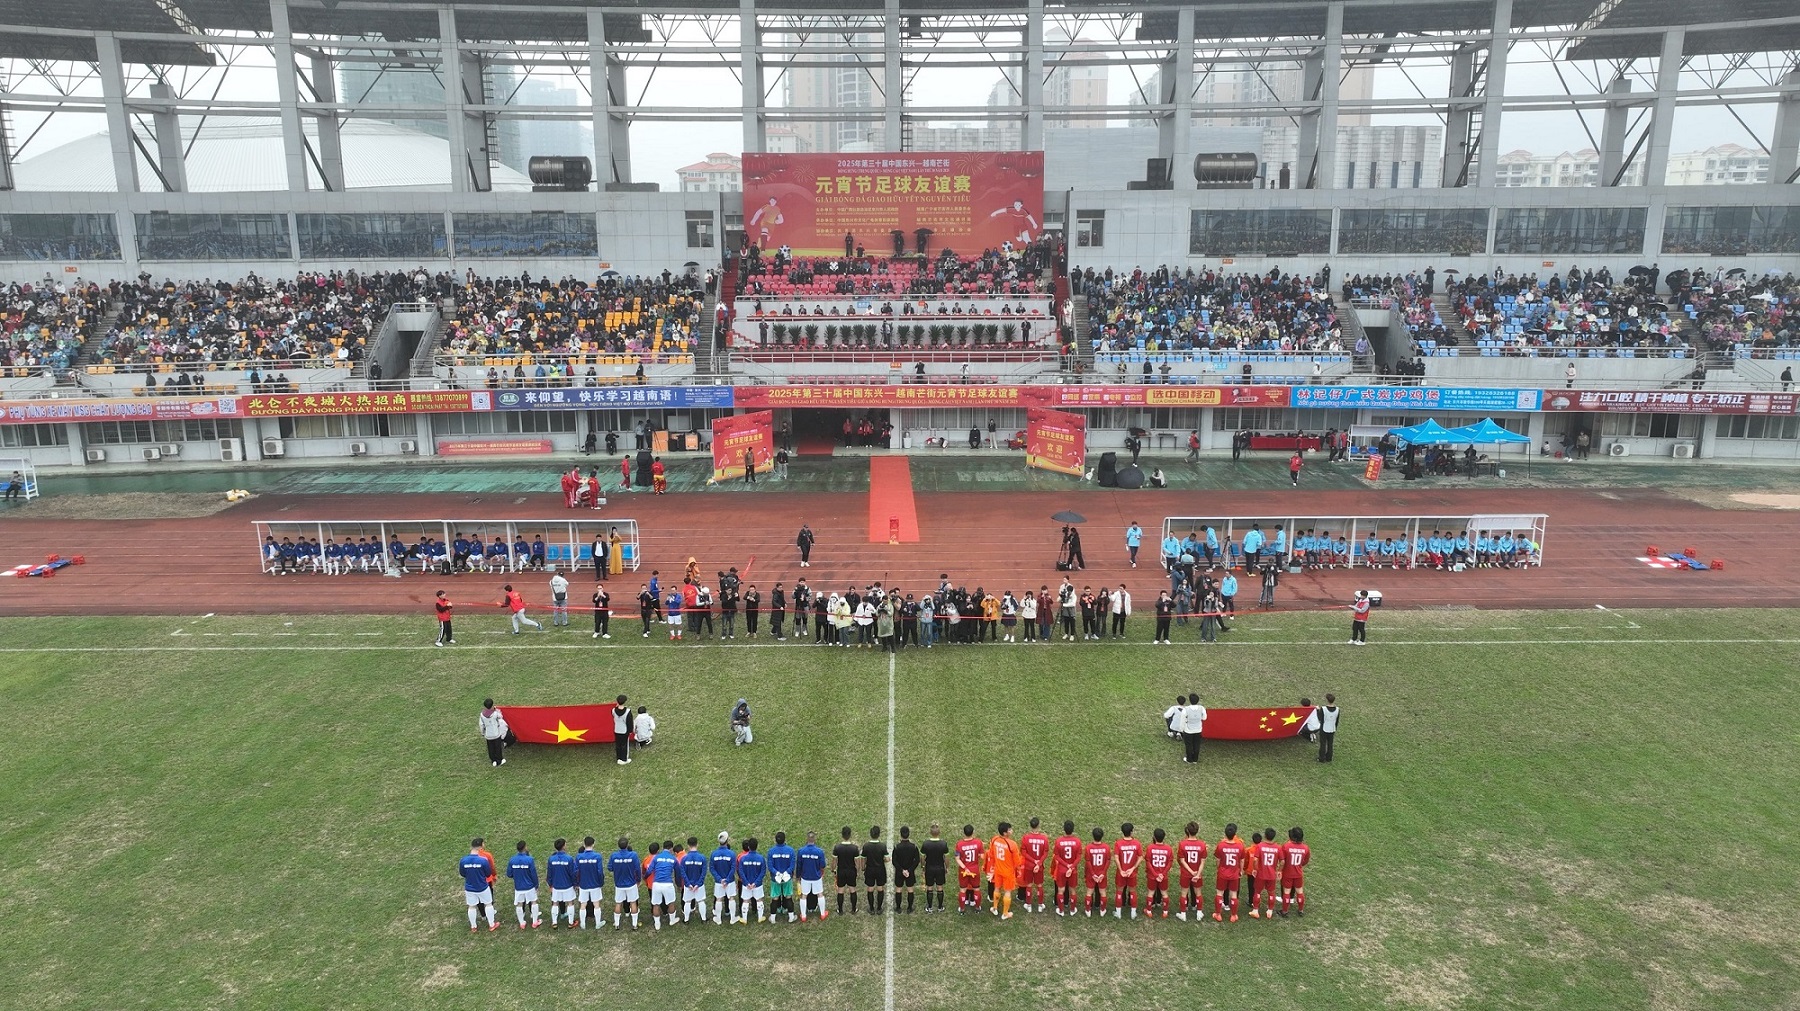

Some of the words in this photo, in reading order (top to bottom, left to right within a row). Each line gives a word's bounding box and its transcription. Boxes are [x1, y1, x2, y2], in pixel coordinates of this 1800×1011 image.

[816, 175, 970, 194] 元宵节足球友谊赛
[1153, 390, 1215, 399] 选中国移动
[1297, 388, 1440, 401] 林记仔广式炭炉鸡煲
[1579, 392, 1634, 402] 注力口腔
[1691, 394, 1746, 404] 专于矫正
[248, 394, 406, 409] 北仑不夜城火热招商
[137, 403, 152, 415] CAO
[1047, 443, 1063, 454] 欢迎
[965, 850, 975, 862] 31
[996, 848, 1005, 861] 12
[1032, 845, 1040, 857] 4
[1064, 846, 1072, 859] 3
[1123, 851, 1134, 864] 17
[1187, 851, 1199, 863] 19
[1092, 854, 1104, 866] 18
[1152, 855, 1166, 868] 22
[1226, 853, 1236, 866] 15
[1264, 853, 1275, 866] 13
[1291, 853, 1302, 866] 10
